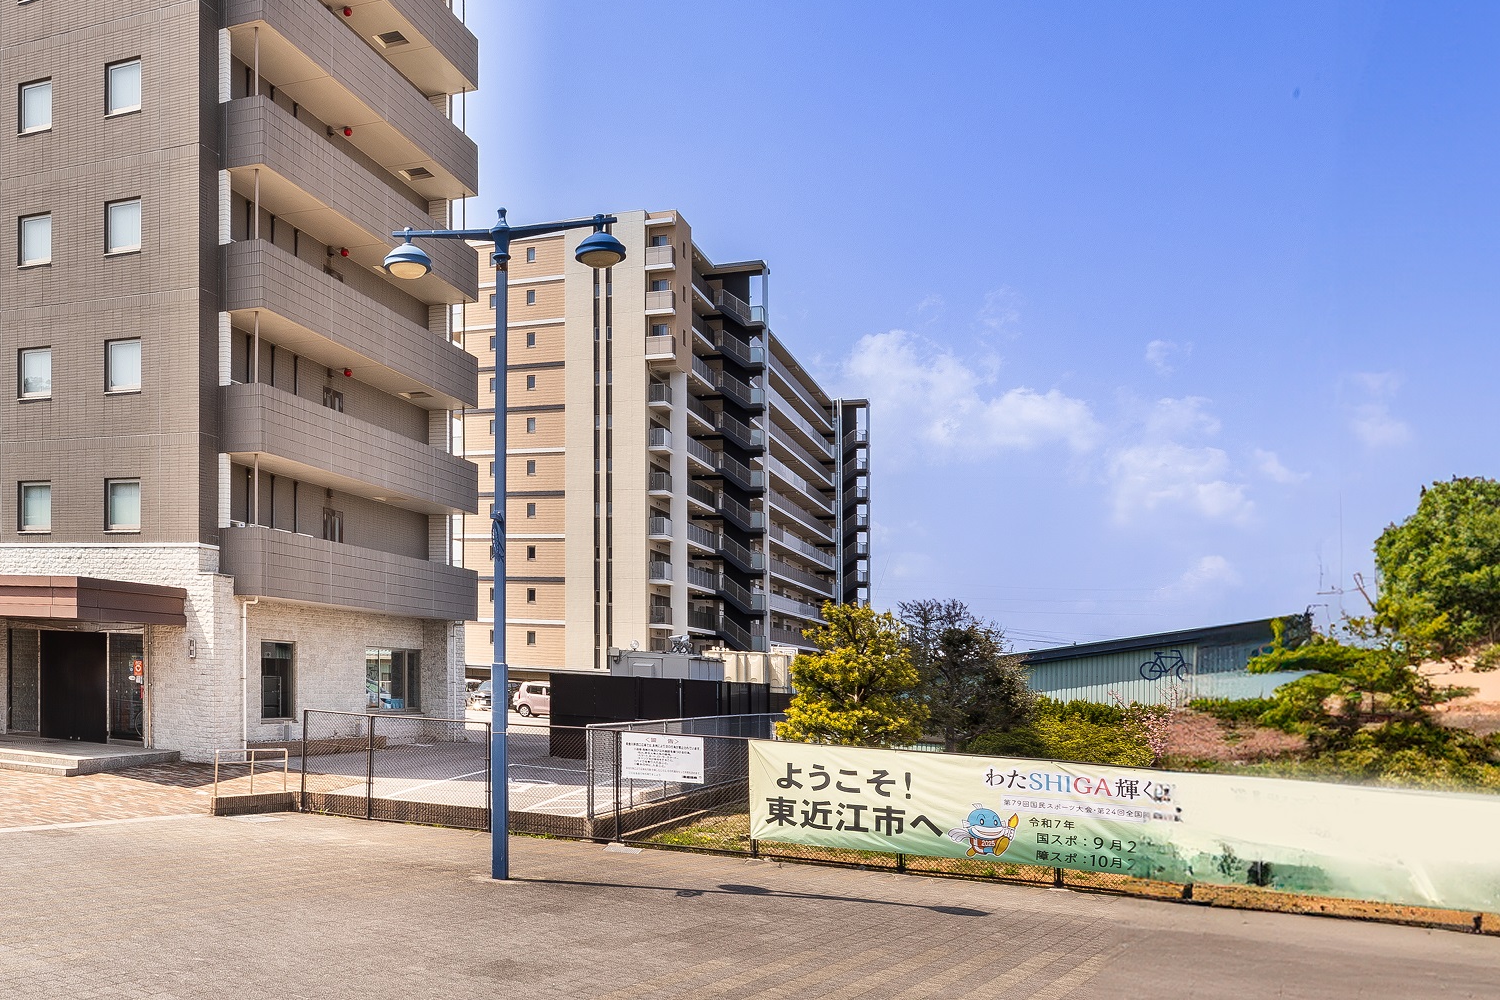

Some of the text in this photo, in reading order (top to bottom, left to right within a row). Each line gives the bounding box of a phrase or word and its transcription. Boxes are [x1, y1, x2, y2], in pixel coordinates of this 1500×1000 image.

[776, 762, 912, 800] ようこそ！
[765, 796, 944, 838] 東近江市へ
[1028, 816, 1076, 831] 令和7年
[981, 839, 996, 847] 2025
